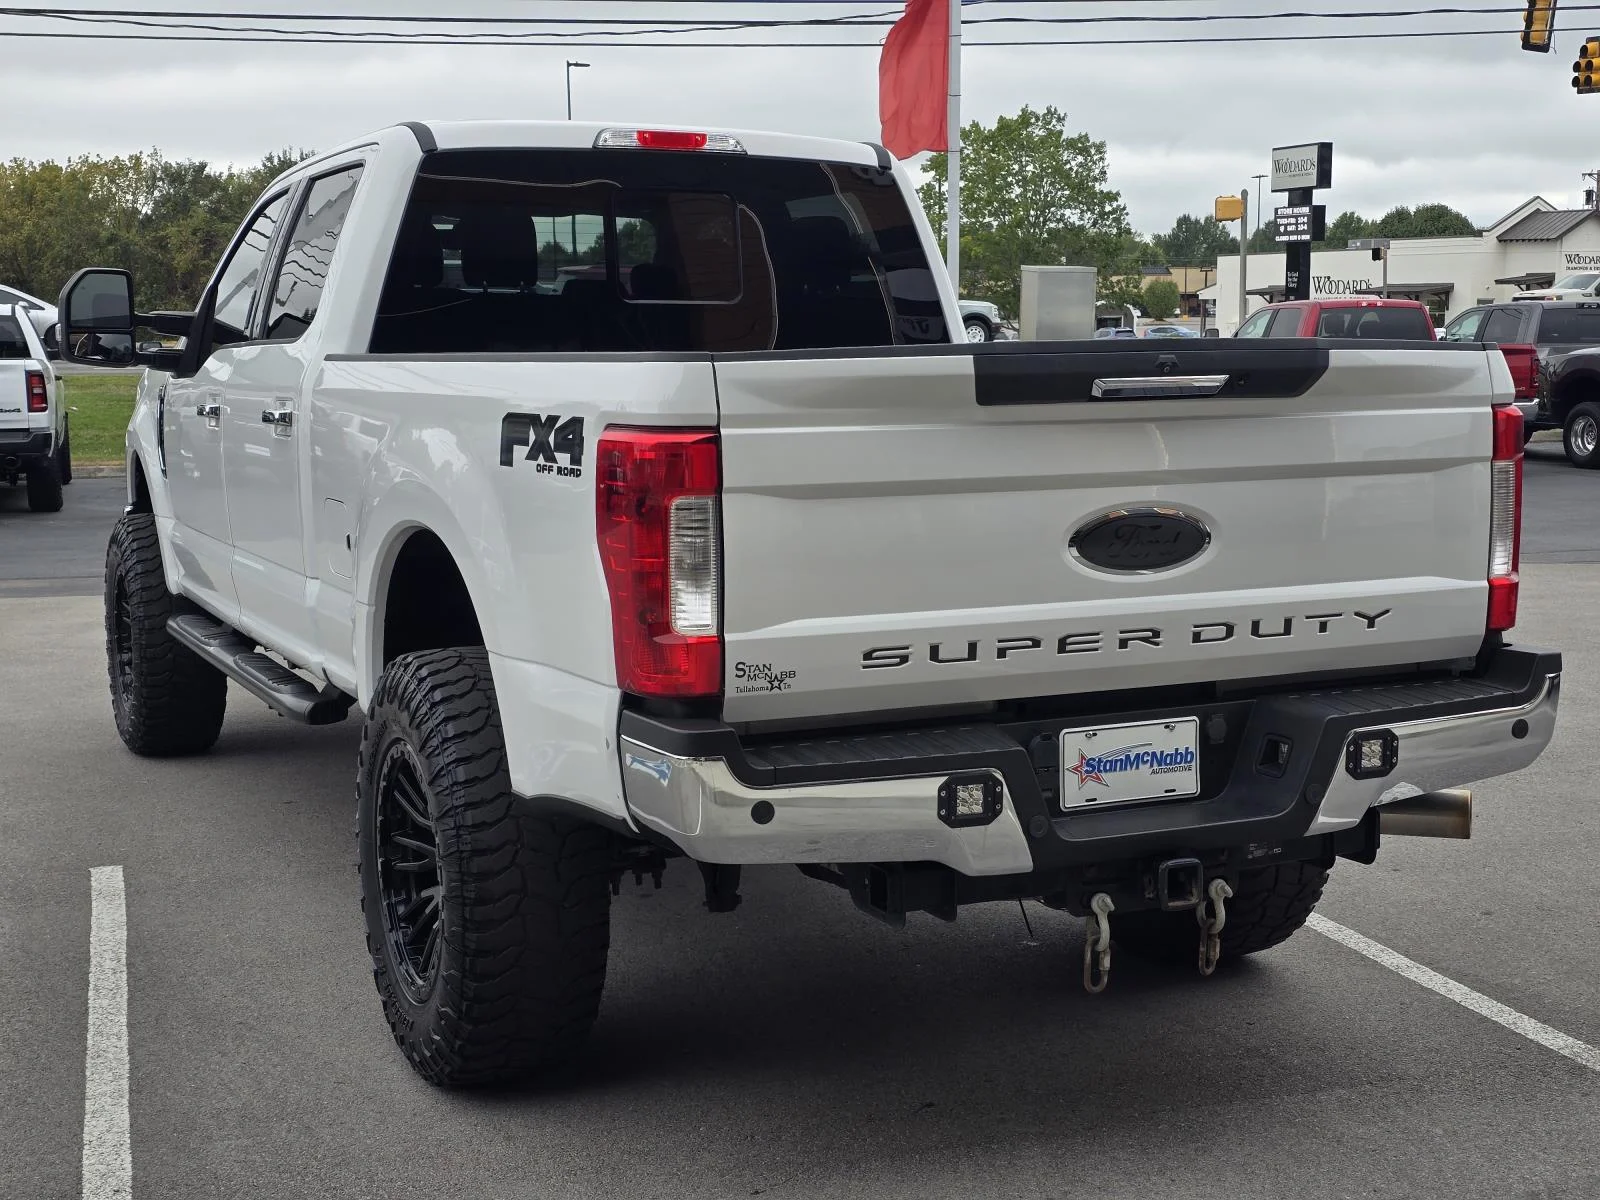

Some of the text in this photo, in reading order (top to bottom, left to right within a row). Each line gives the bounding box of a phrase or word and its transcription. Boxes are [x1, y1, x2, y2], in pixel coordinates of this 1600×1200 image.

[500, 411, 585, 467] FX4
[536, 463, 582, 478] OFF ROAD
[861, 608, 1392, 670] SUPER DUTY
[735, 661, 772, 678] STAN
[1150, 764, 1193, 776] AUTOMOTIVE
